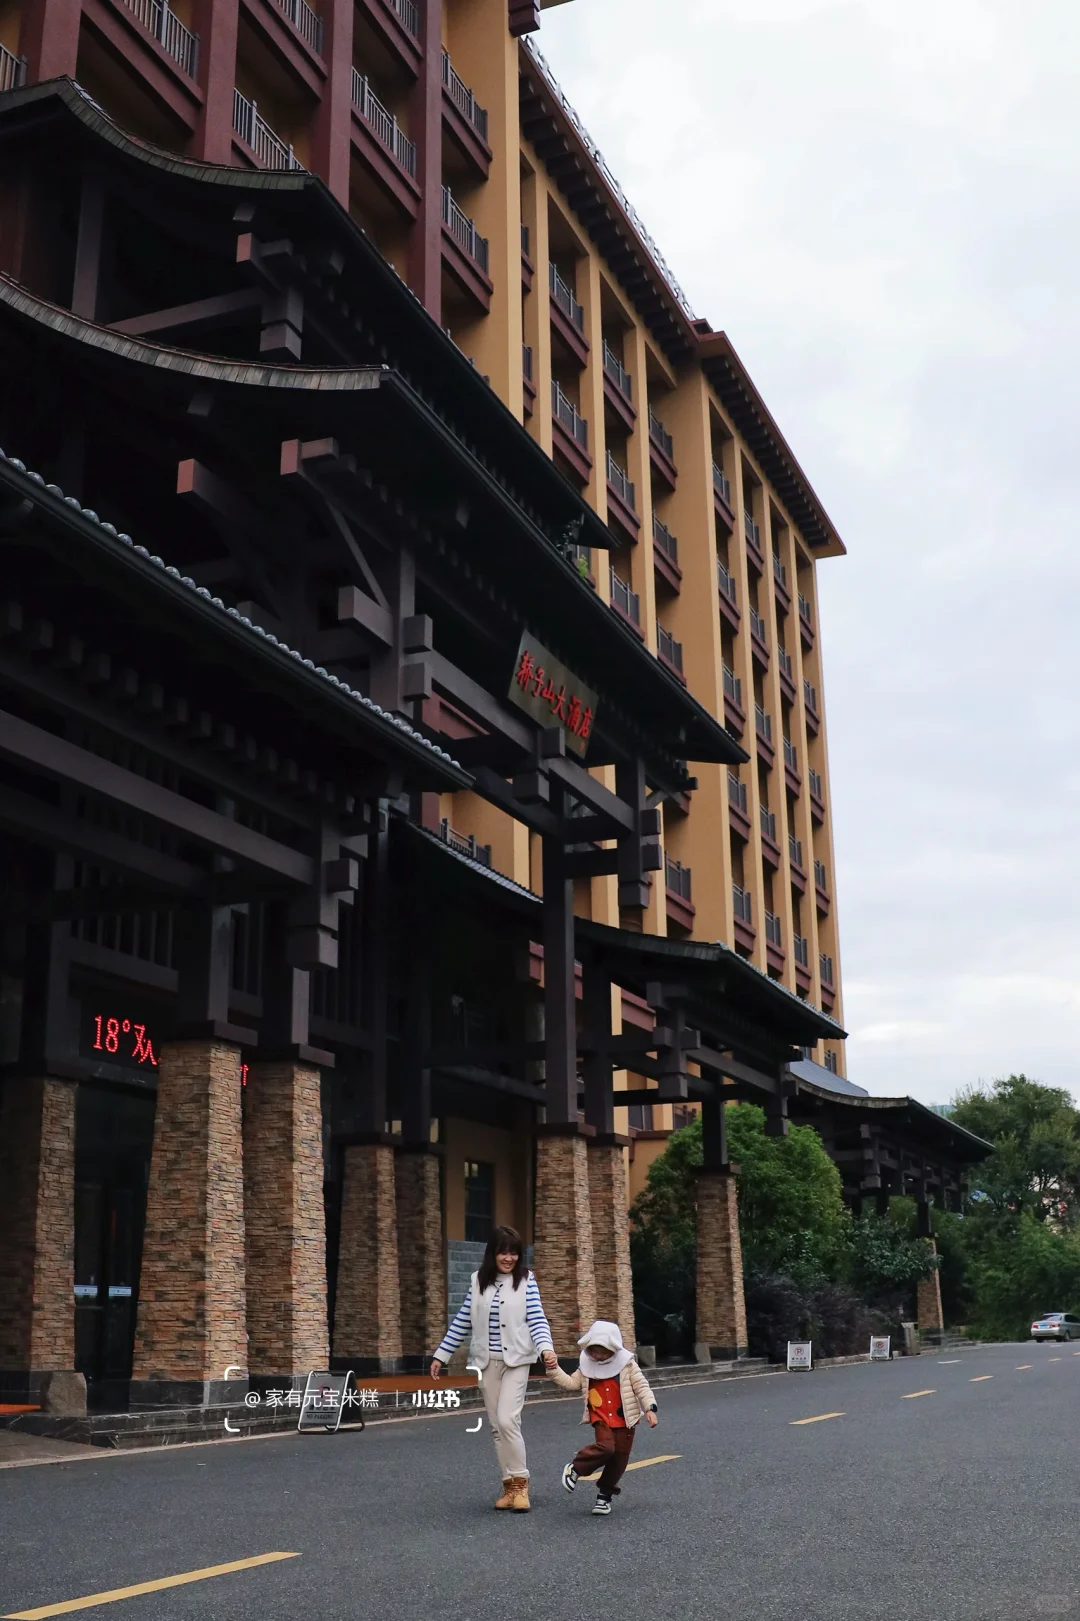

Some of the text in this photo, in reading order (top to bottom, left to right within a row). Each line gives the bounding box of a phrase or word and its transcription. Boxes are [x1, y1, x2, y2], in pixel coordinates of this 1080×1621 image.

[517, 650, 593, 738] 轿子山大酒店
